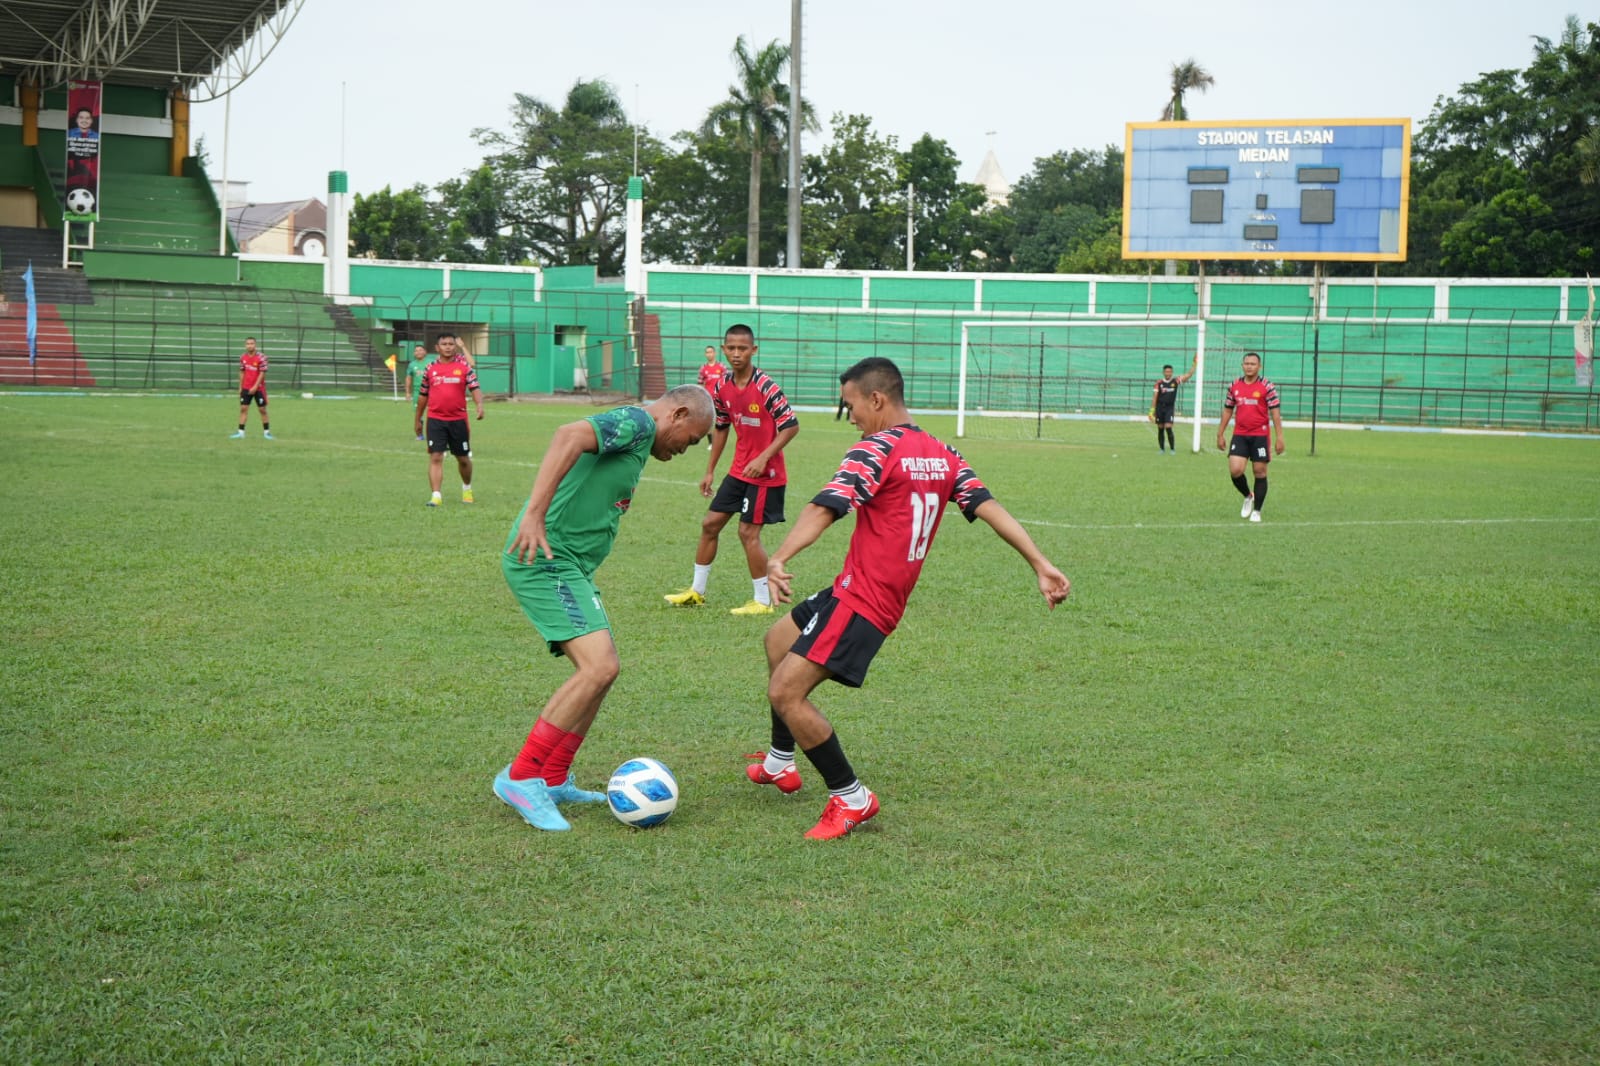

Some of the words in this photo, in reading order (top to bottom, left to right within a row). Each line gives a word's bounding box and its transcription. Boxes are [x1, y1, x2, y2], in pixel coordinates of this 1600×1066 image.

[1198, 131, 1258, 145] STADION
[1265, 130, 1334, 144] TELADAN
[1239, 148, 1289, 162] MEDAN
[742, 497, 750, 513] 3
[907, 492, 940, 562] 19
